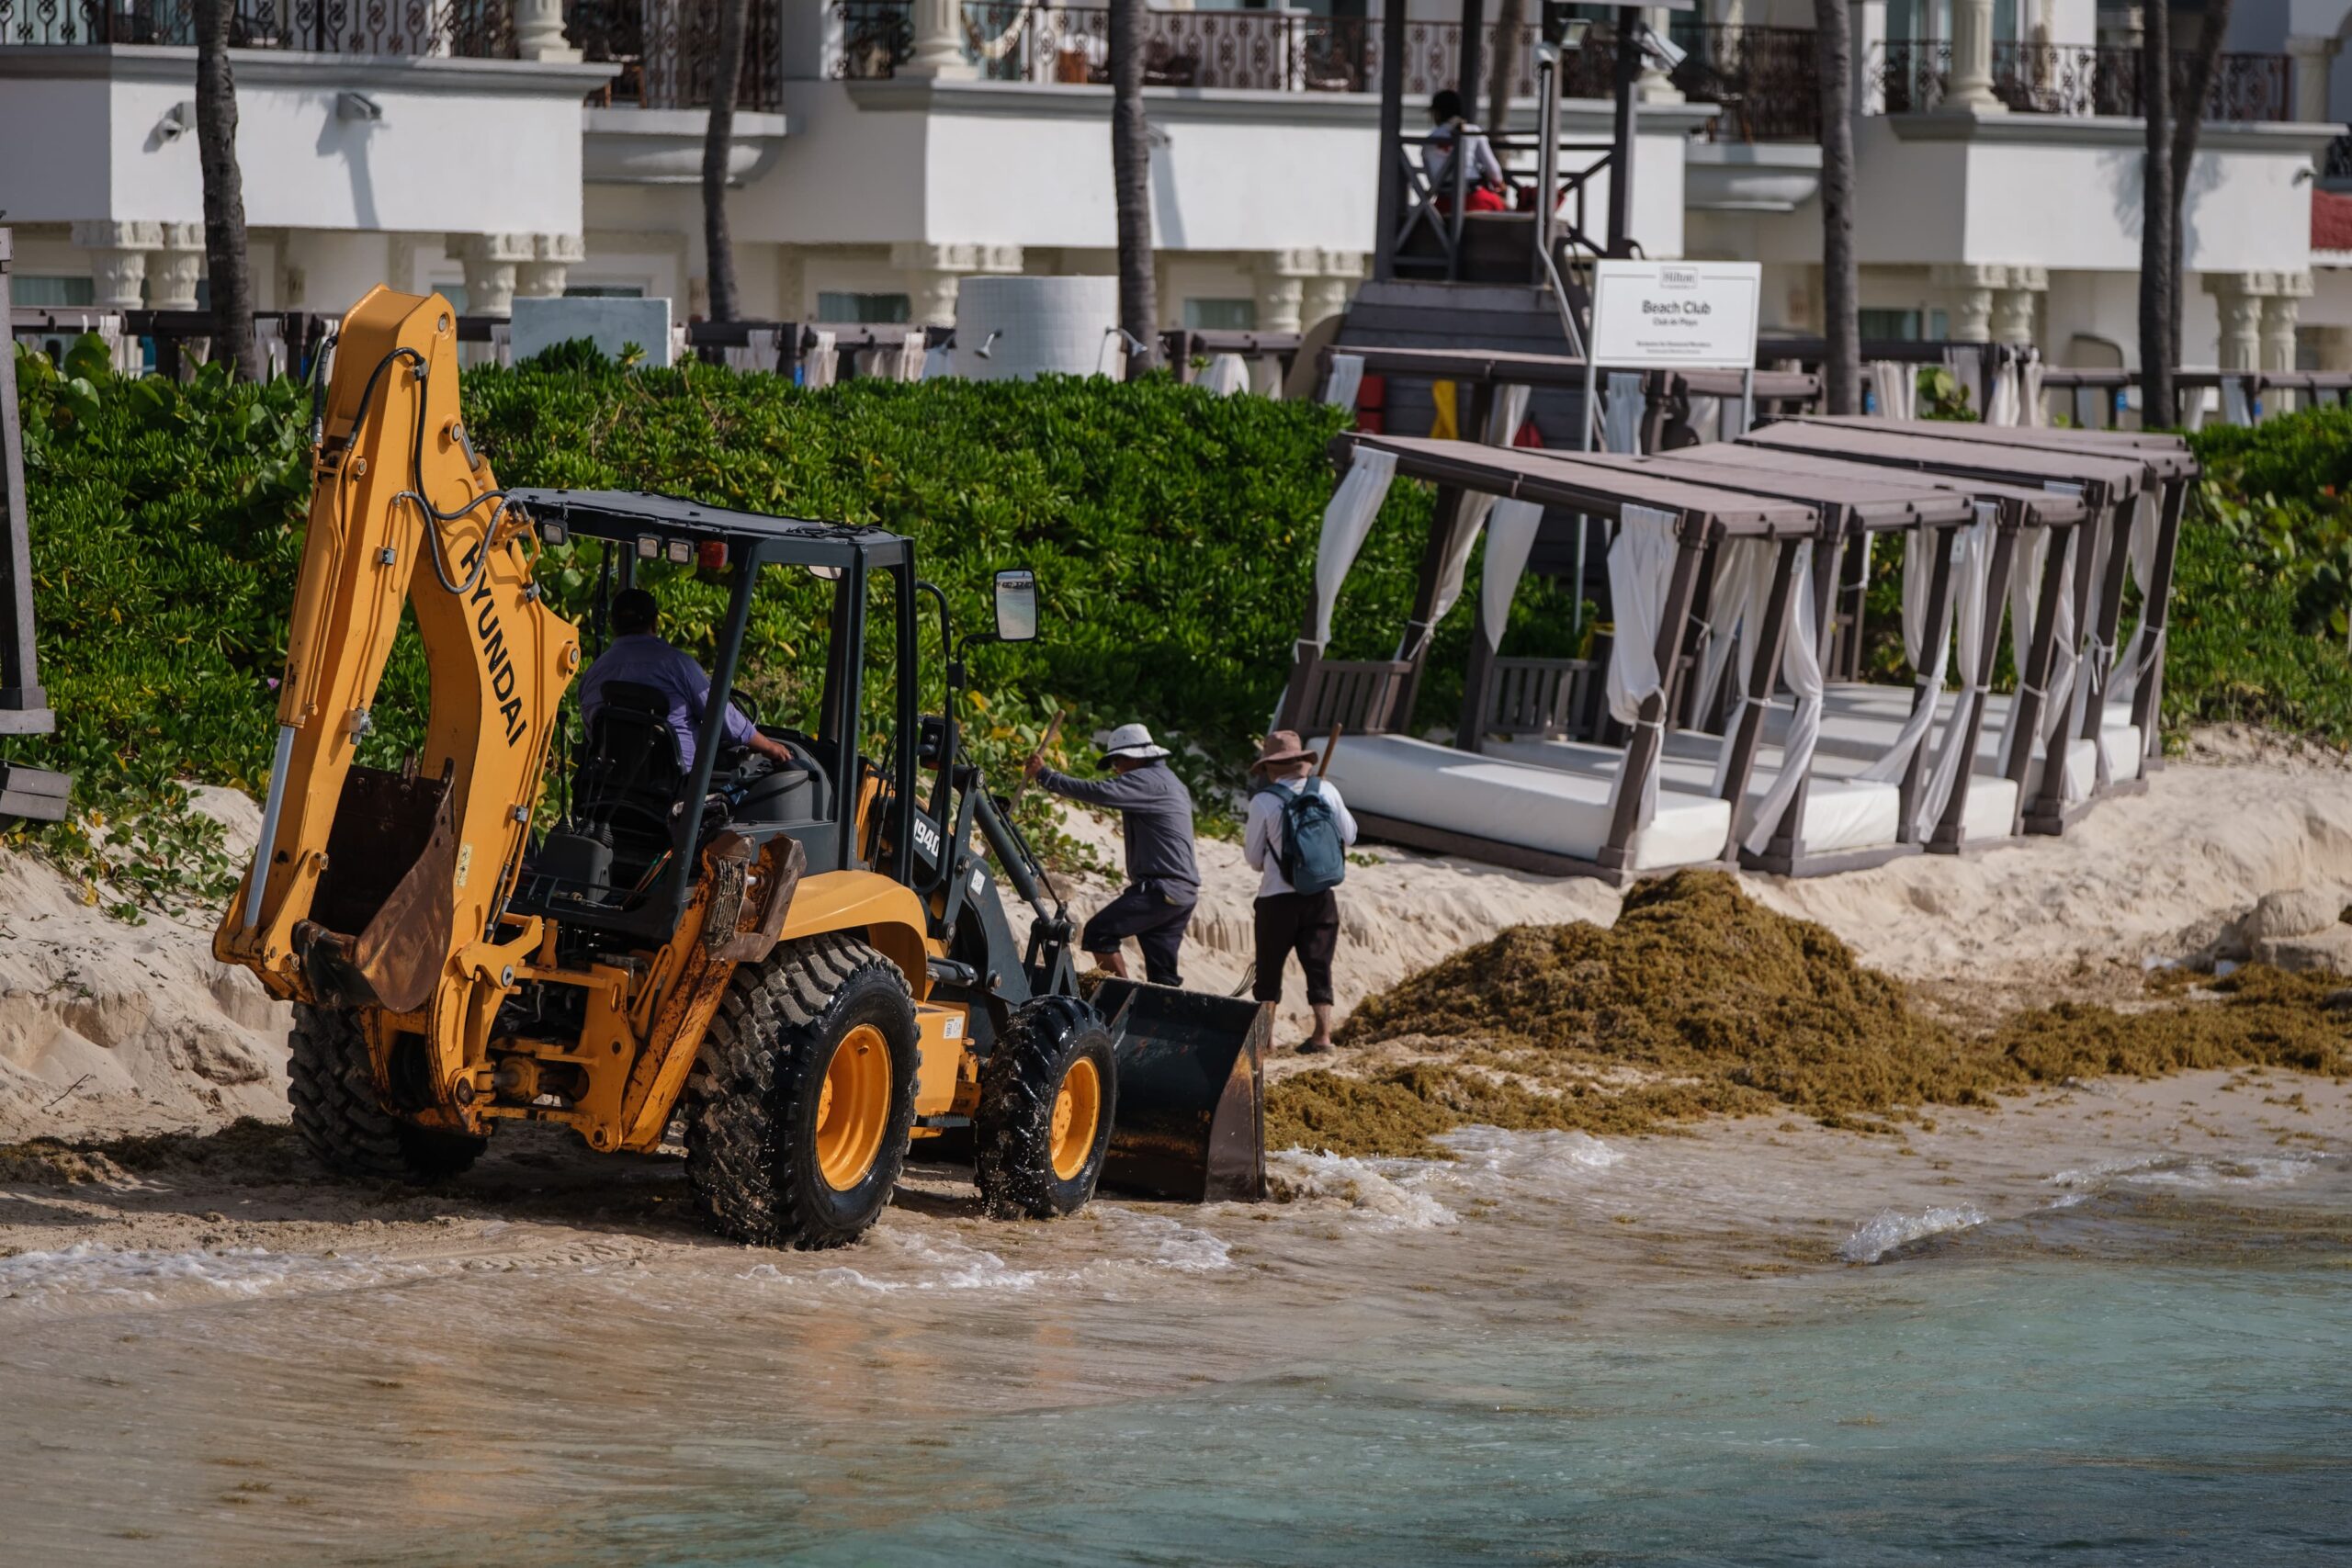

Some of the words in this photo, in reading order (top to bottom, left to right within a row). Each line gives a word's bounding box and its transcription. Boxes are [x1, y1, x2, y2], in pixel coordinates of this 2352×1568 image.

[1642, 299, 1680, 314] Beach
[1682, 299, 1712, 315] Club
[460, 540, 527, 748] HYUNDAI
